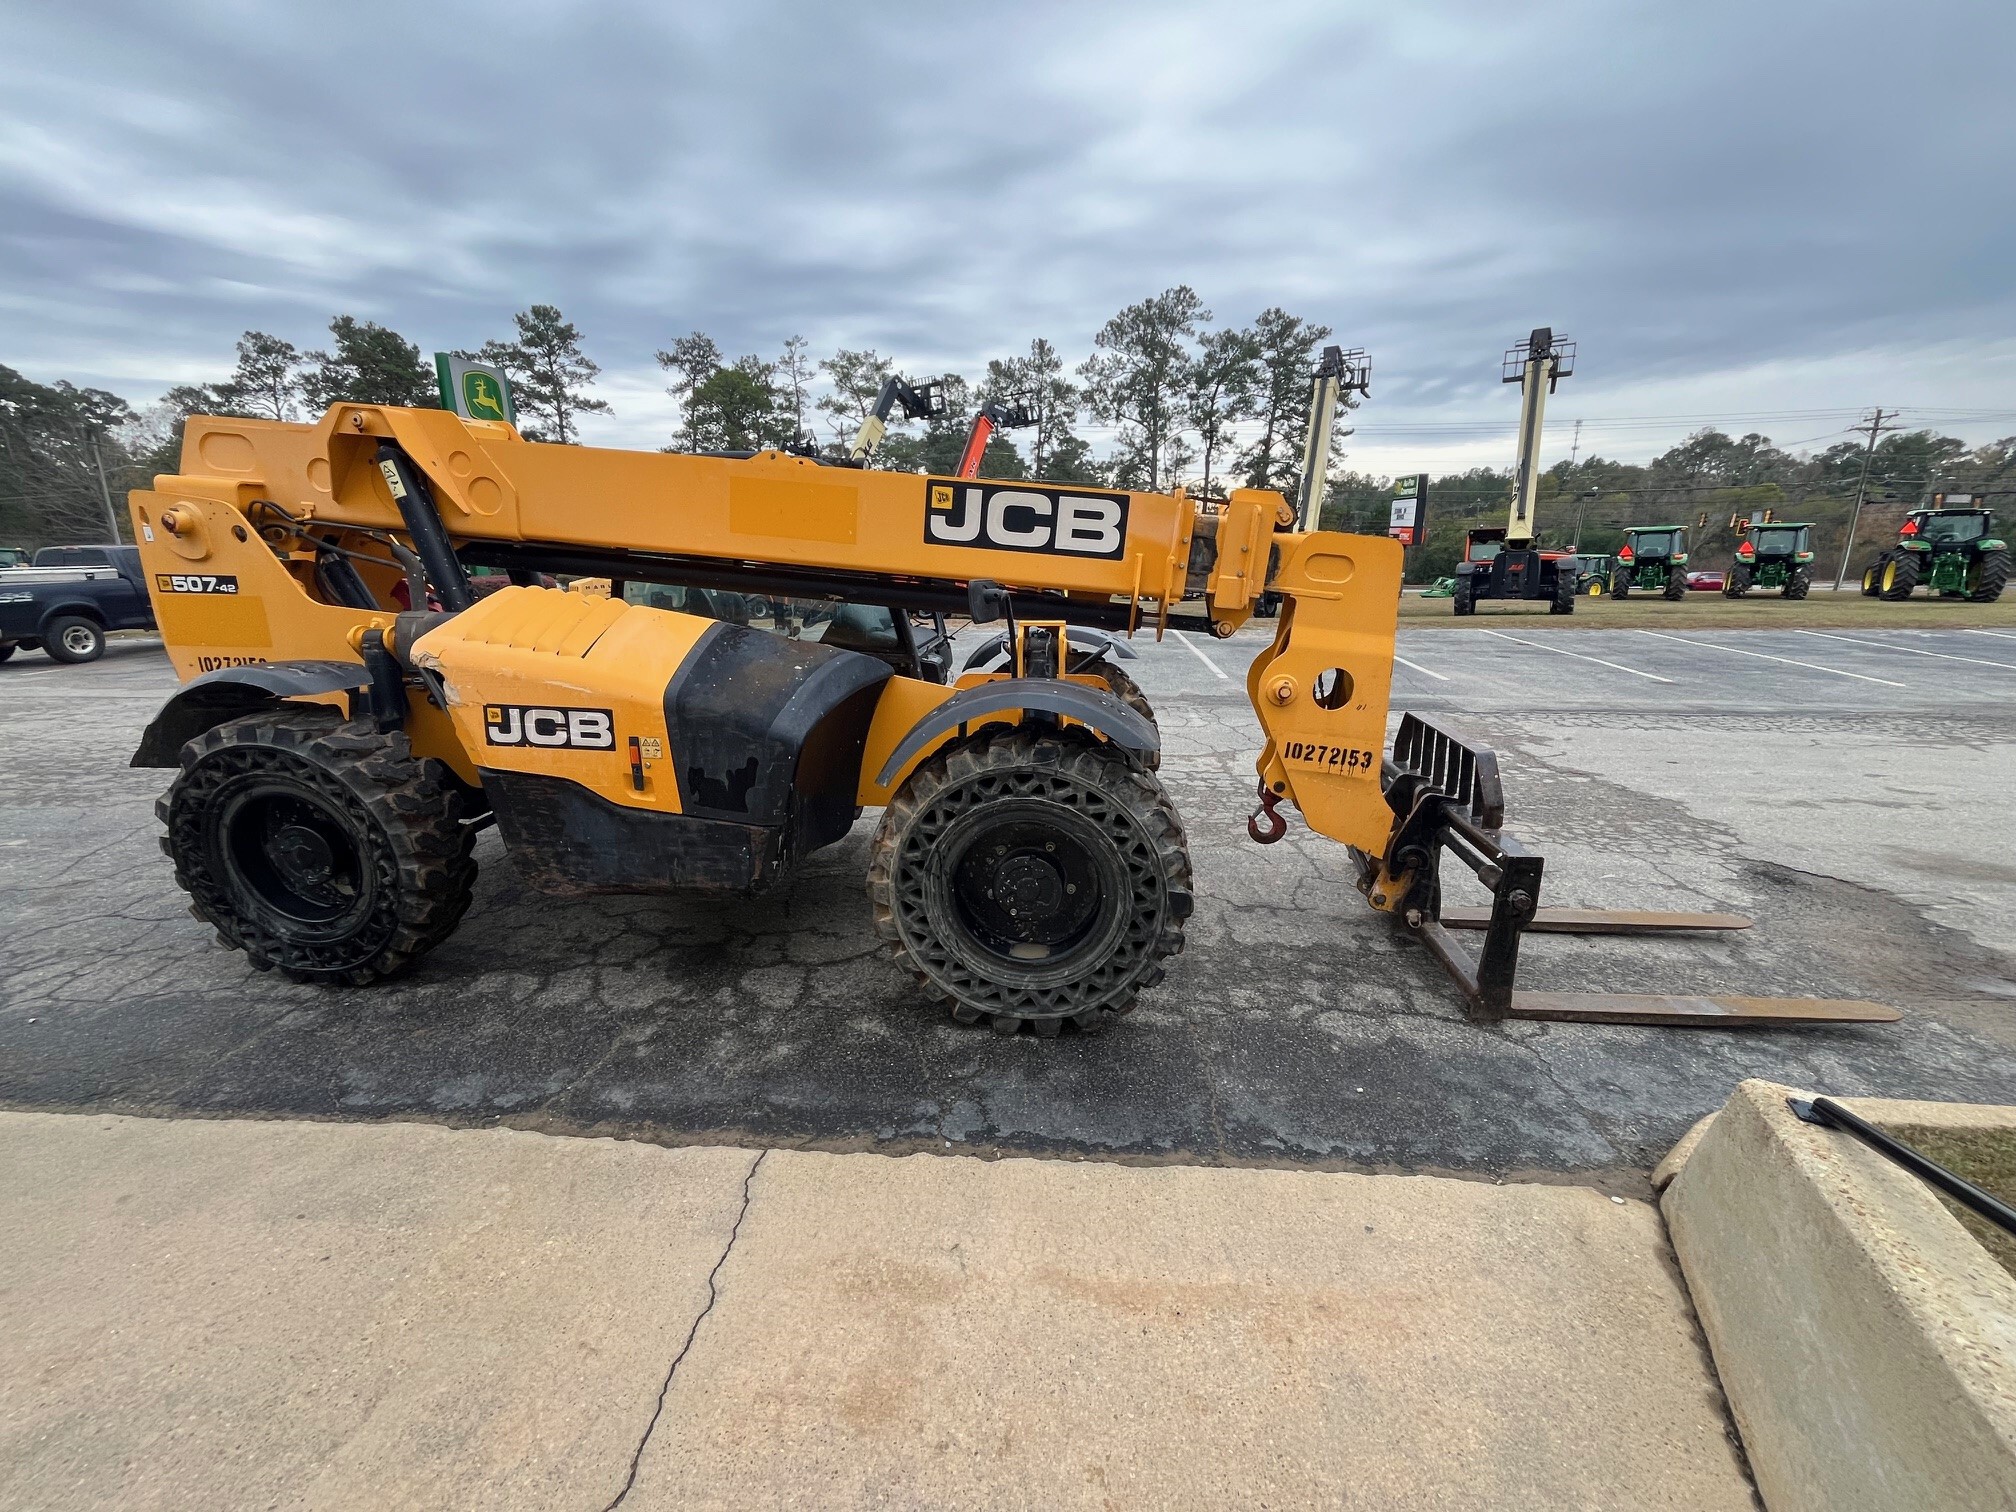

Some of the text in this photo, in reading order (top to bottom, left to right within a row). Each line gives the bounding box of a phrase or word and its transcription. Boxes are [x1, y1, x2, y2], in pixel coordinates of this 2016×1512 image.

[930, 488, 1122, 554] JCB
[488, 708, 613, 747] JCB
[1284, 742, 1373, 769] 10272153
